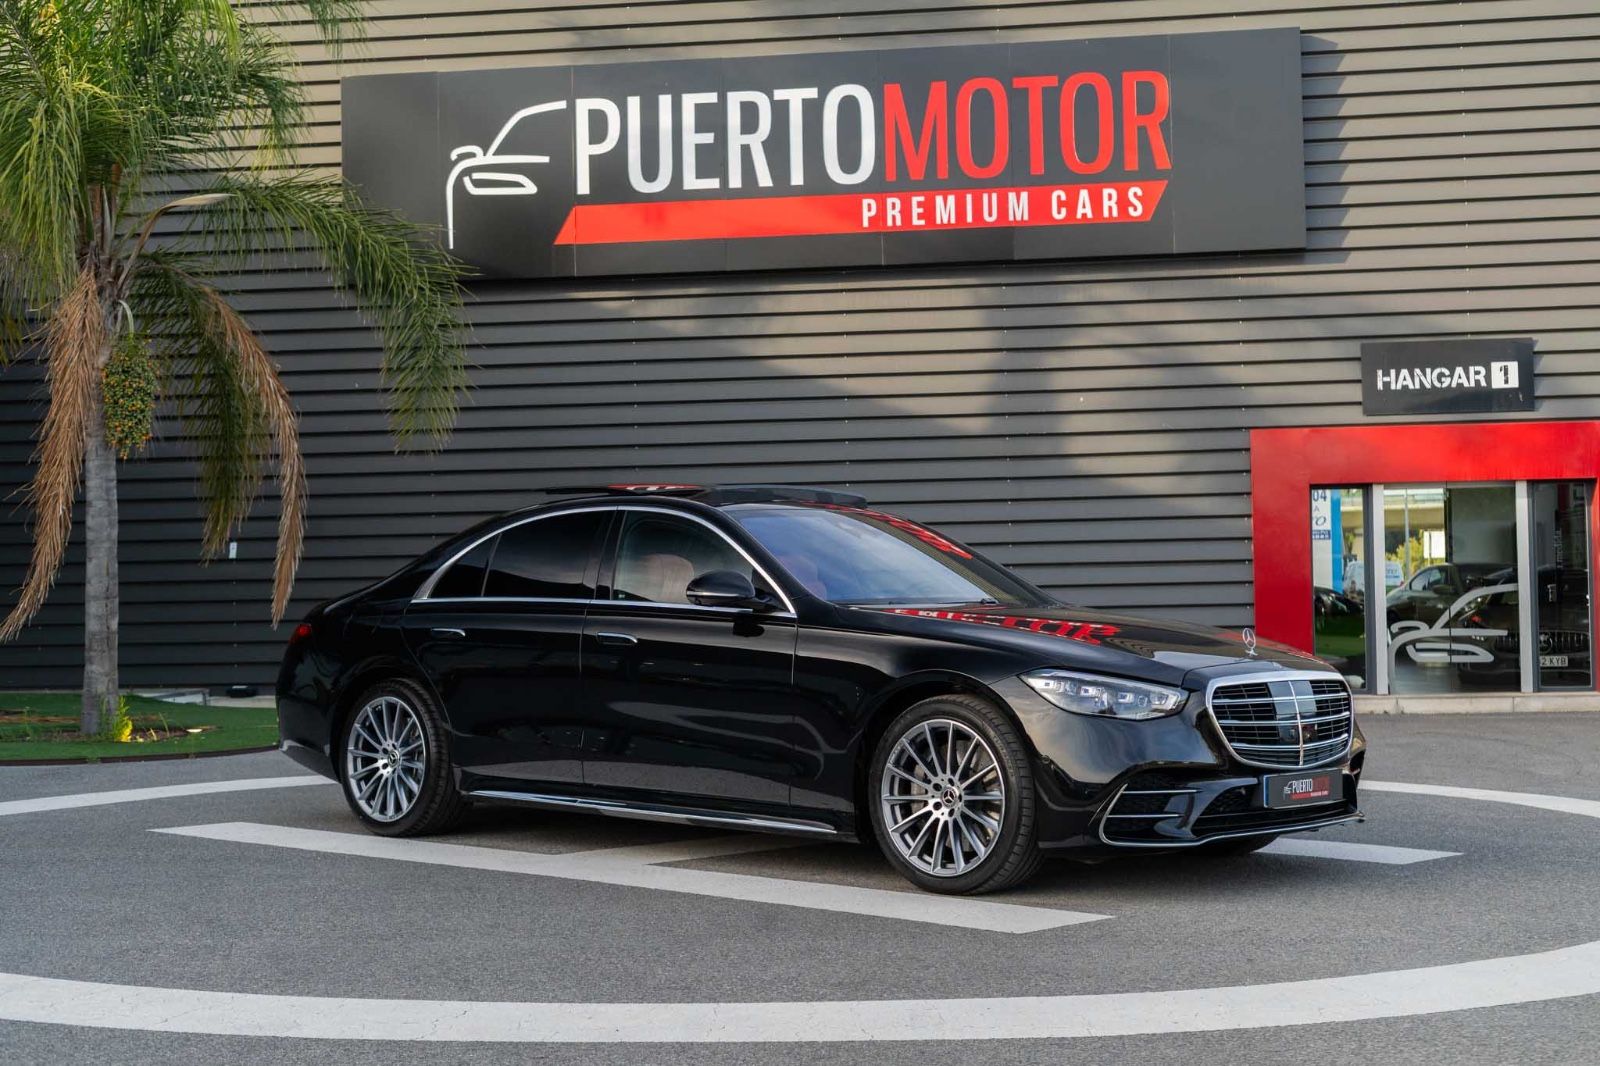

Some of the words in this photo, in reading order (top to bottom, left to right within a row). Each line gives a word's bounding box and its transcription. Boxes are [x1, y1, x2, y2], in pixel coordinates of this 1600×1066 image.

[861, 191, 1030, 228] PREMIUM
[1051, 186, 1145, 220] CARS
[1376, 365, 1488, 391] HANGAR
